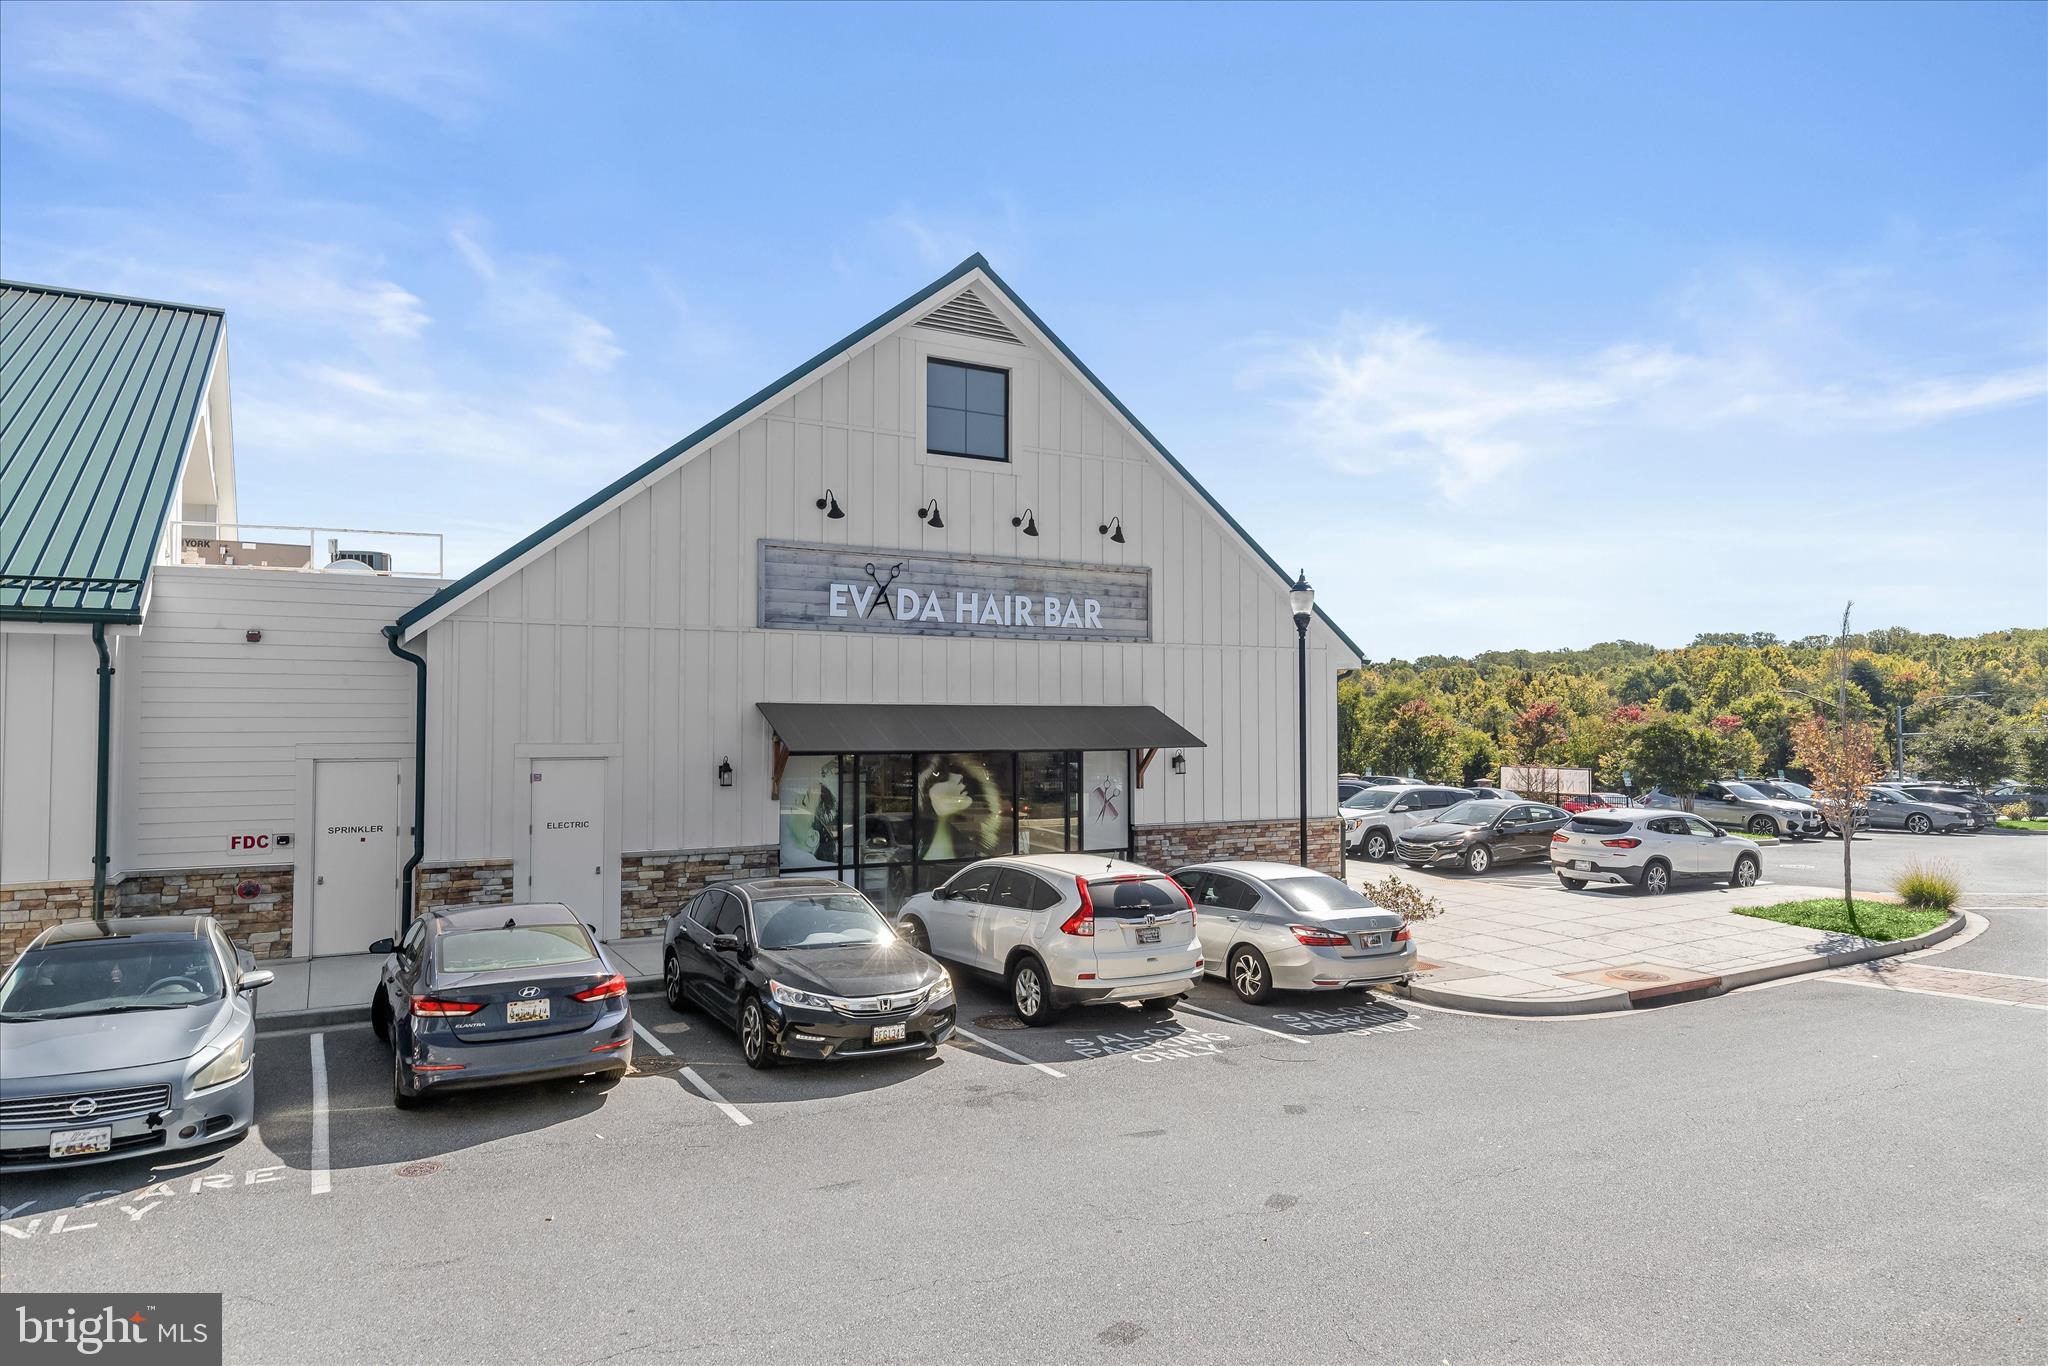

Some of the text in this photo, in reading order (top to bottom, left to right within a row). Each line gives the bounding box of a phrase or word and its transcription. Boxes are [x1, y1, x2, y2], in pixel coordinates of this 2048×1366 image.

[185, 539, 210, 548] YORK
[829, 563, 1103, 629] EVADA HAIR BAR
[327, 825, 384, 835] SPRINKLER
[546, 821, 590, 830] ELECTRIC
[231, 834, 269, 849] FDC
[1131, 1044, 1224, 1063] ONLY
